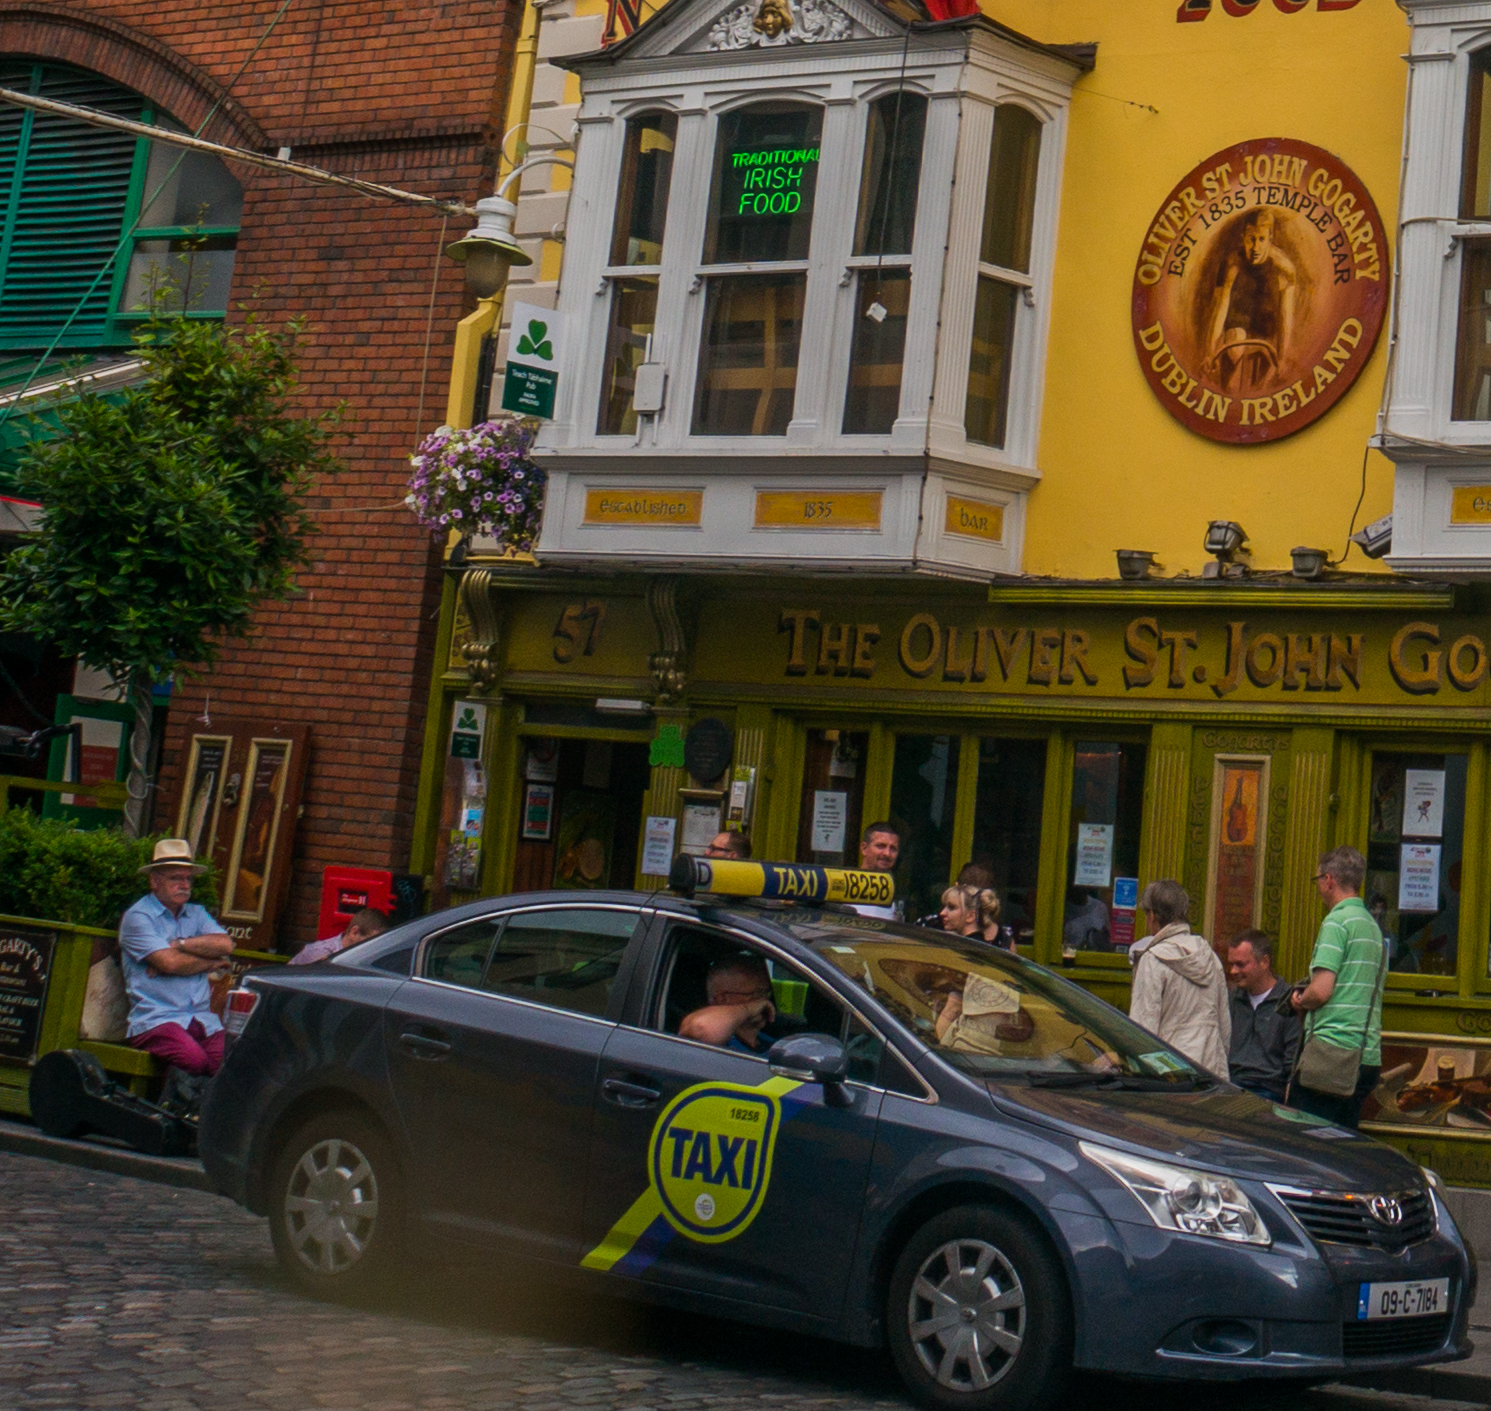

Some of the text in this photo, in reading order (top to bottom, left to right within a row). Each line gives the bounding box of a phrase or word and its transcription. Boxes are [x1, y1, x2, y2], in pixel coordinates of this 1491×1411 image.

[731, 147, 821, 169] TRADITIONAL
[743, 166, 804, 190] IRISH
[738, 191, 801, 215] FOOD
[1137, 153, 1381, 288] OLIVER ST JOHN GOGARTY
[1167, 185, 1351, 285] EST 1835 TEMPLE BAR
[1138, 315, 1365, 427] DUBLIN IRELAND
[802, 501, 834, 521] 1835
[775, 605, 881, 681] THE
[898, 610, 1099, 690] OLIVER
[773, 867, 819, 897] TAXI
[843, 872, 890, 901] 18258
[0, 937, 43, 971] GARTY'S
[730, 1108, 760, 1123] 18258
[668, 1126, 758, 1190] TAXI
[1381, 1286, 1438, 1316] 09-C-7184
